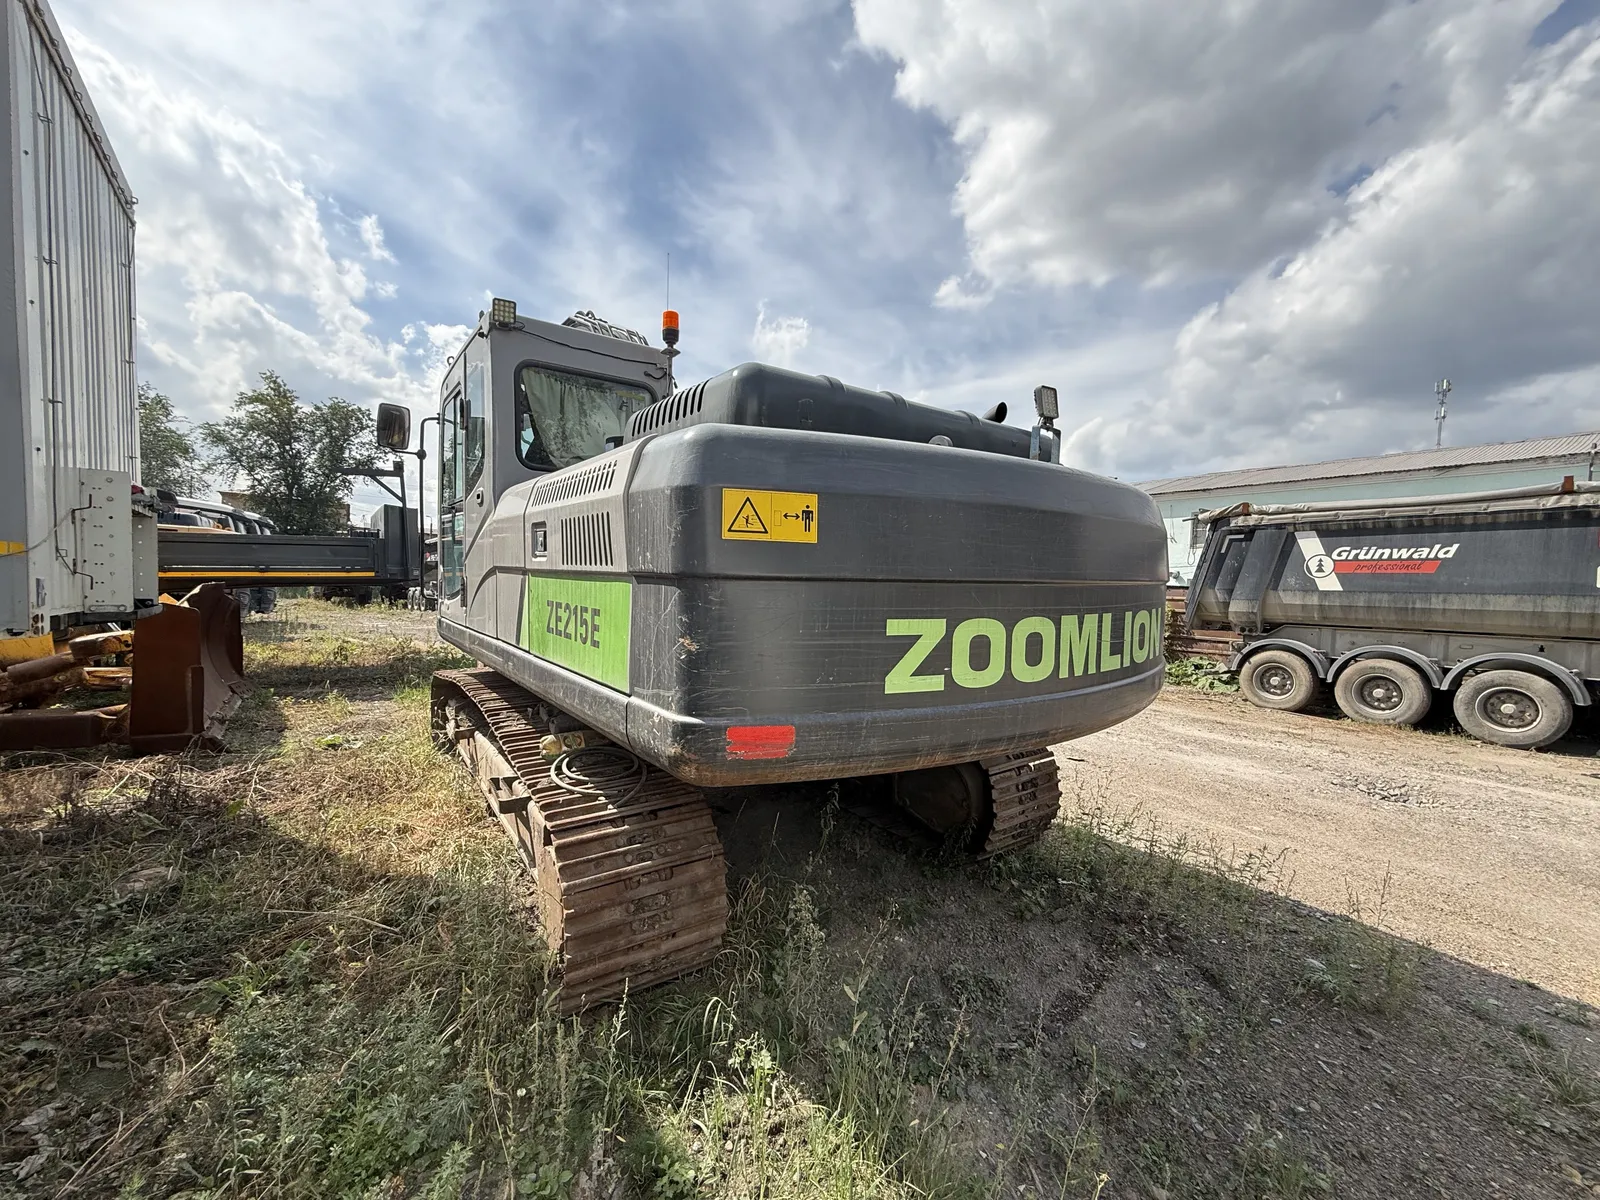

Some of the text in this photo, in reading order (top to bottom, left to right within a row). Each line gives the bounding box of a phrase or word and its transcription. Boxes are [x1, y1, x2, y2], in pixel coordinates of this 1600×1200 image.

[1331, 543, 1460, 561] Grünwald
[1353, 560, 1426, 573] professional
[546, 599, 601, 649] ZE215E
[884, 607, 1162, 694] ZOOMLION
